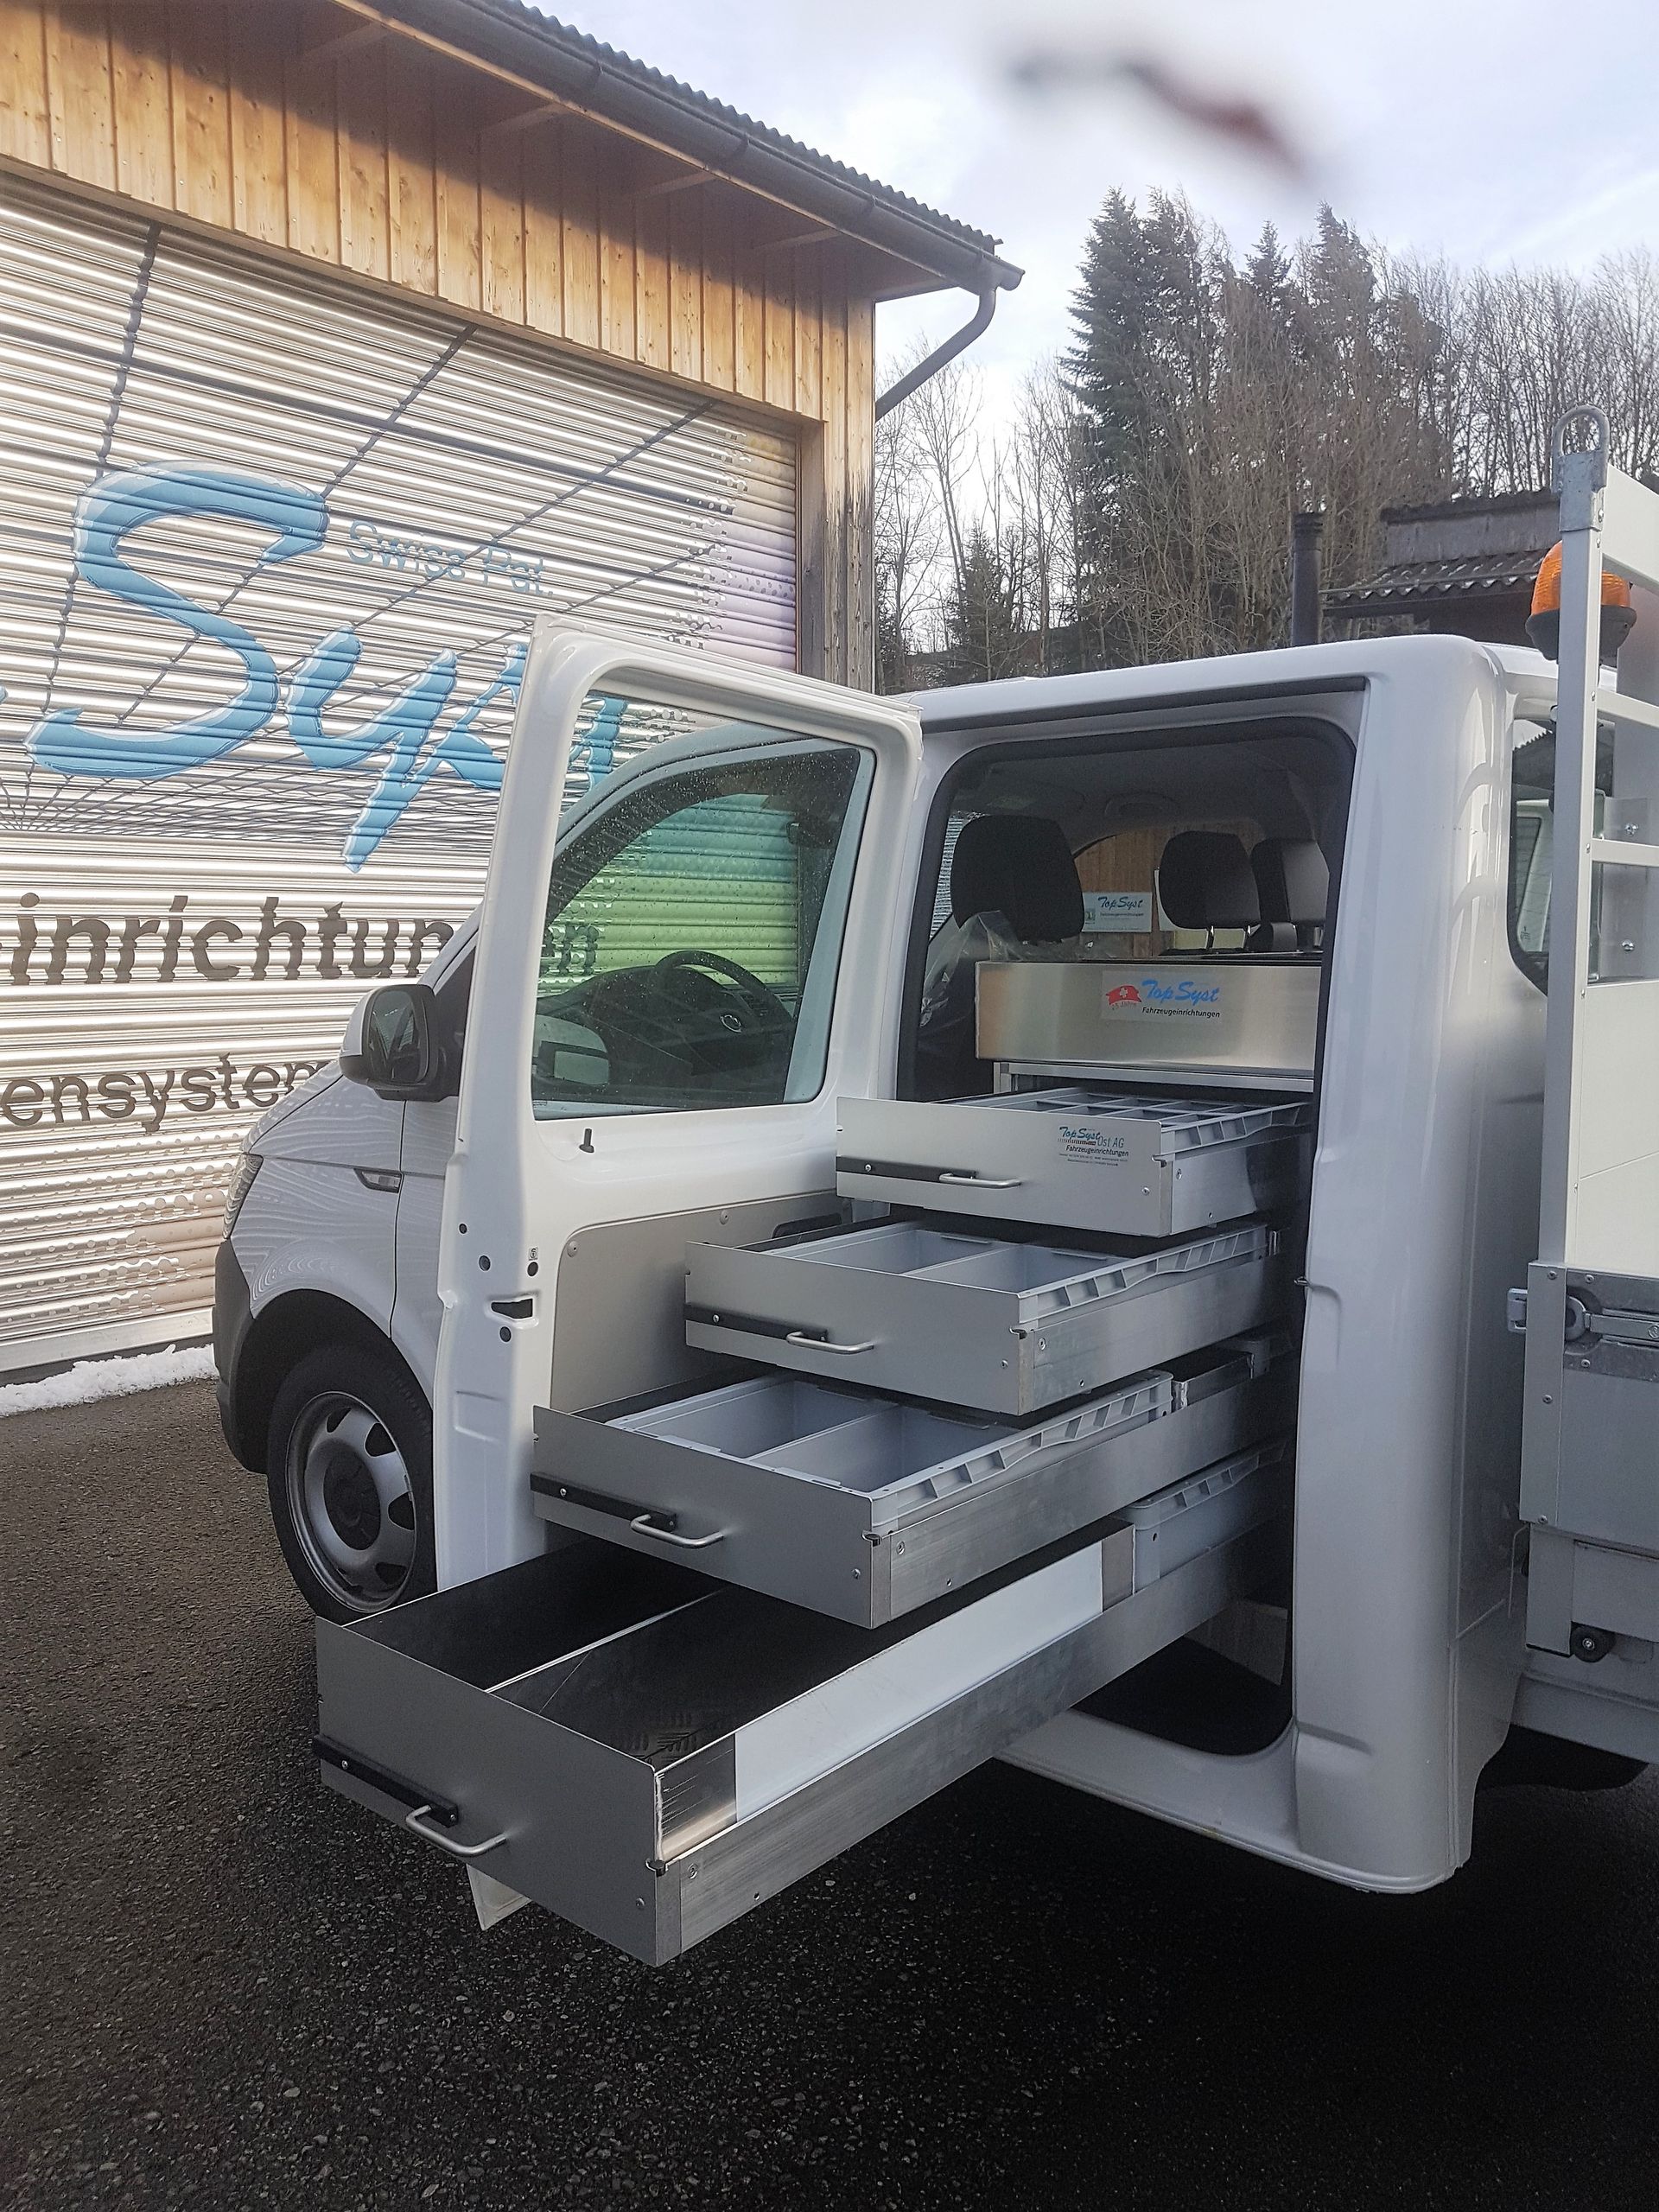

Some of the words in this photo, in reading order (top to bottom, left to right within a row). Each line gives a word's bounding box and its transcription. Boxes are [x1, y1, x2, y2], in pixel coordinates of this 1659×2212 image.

[346, 519, 466, 580] Swiss
[1141, 1007, 1221, 1019] Fahrzeugeinrichtungen
[1112, 1137, 1125, 1148] AG
[1065, 1144, 1130, 1158] Fahrzeugeinrichtungen
